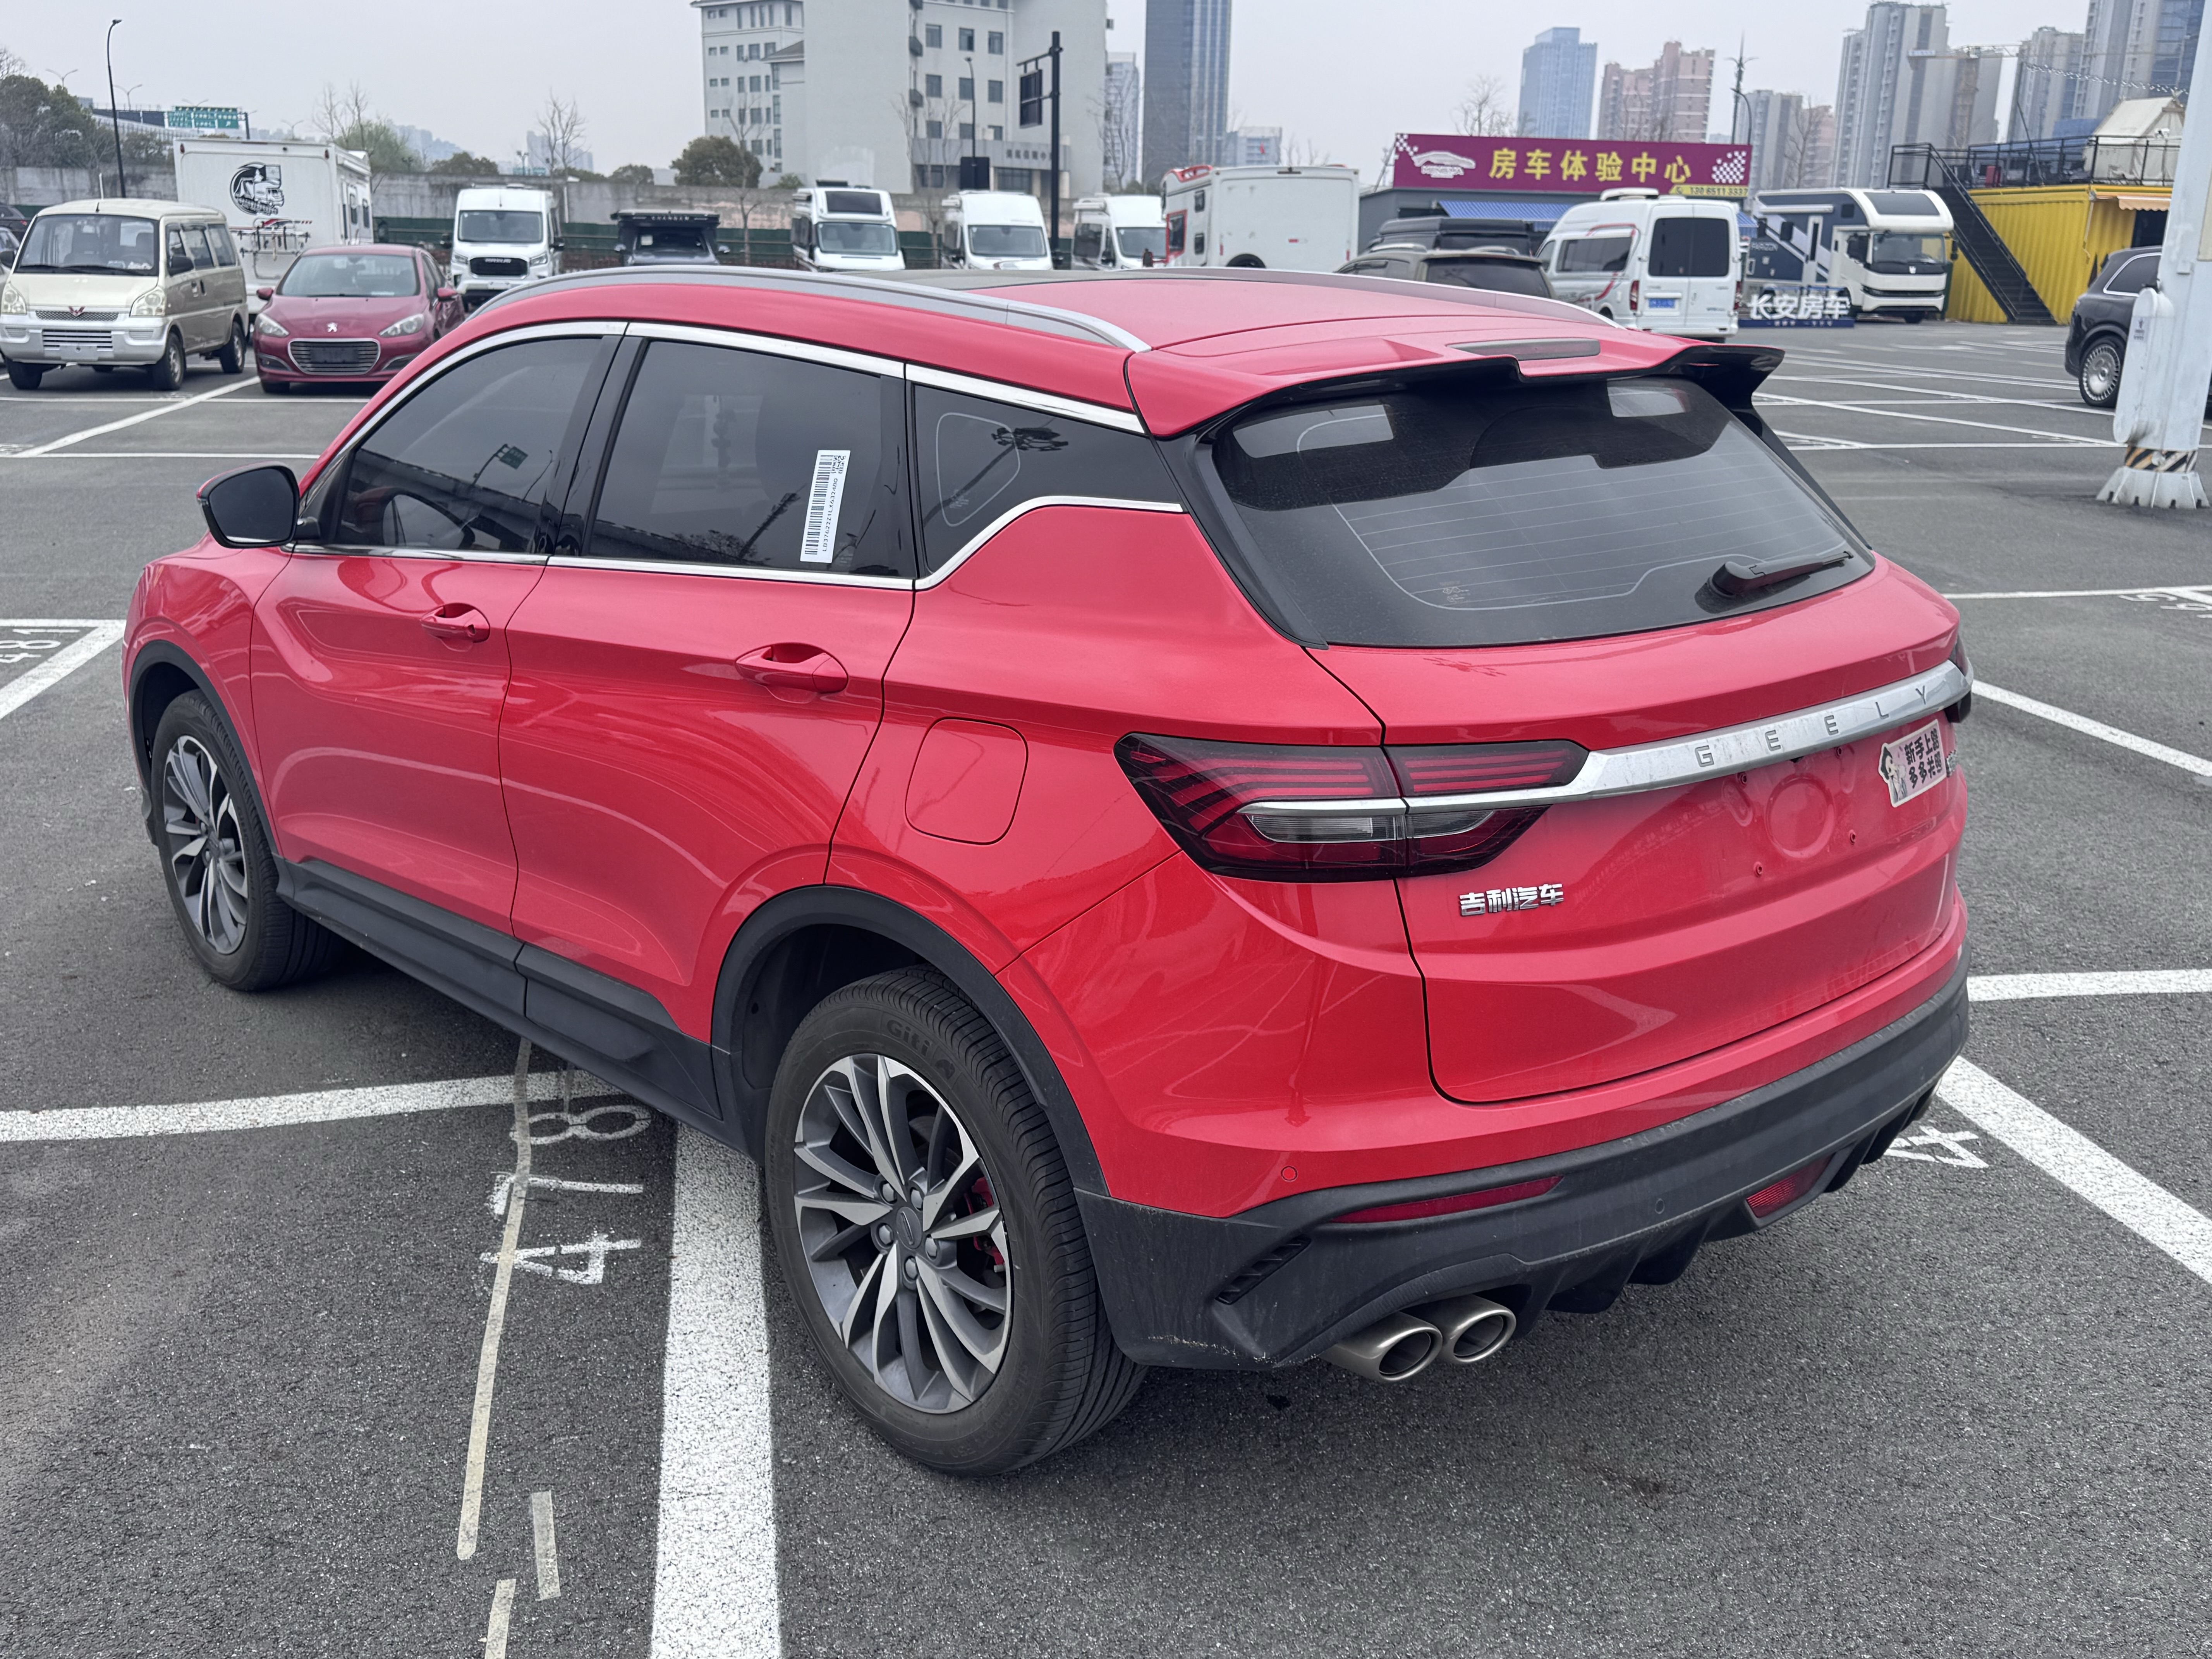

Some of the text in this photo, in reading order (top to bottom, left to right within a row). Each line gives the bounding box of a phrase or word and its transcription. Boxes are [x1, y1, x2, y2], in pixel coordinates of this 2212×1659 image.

[1489, 148, 1691, 184] 房车体验中心
[1747, 293, 1851, 320] 长安房车
[1694, 685, 1927, 768] GEELY
[1904, 728, 1940, 766] 新手上路
[1909, 751, 1942, 789] 多多关照
[1459, 883, 1564, 916] 吉利汽车
[886, 1020, 931, 1056] Giti
